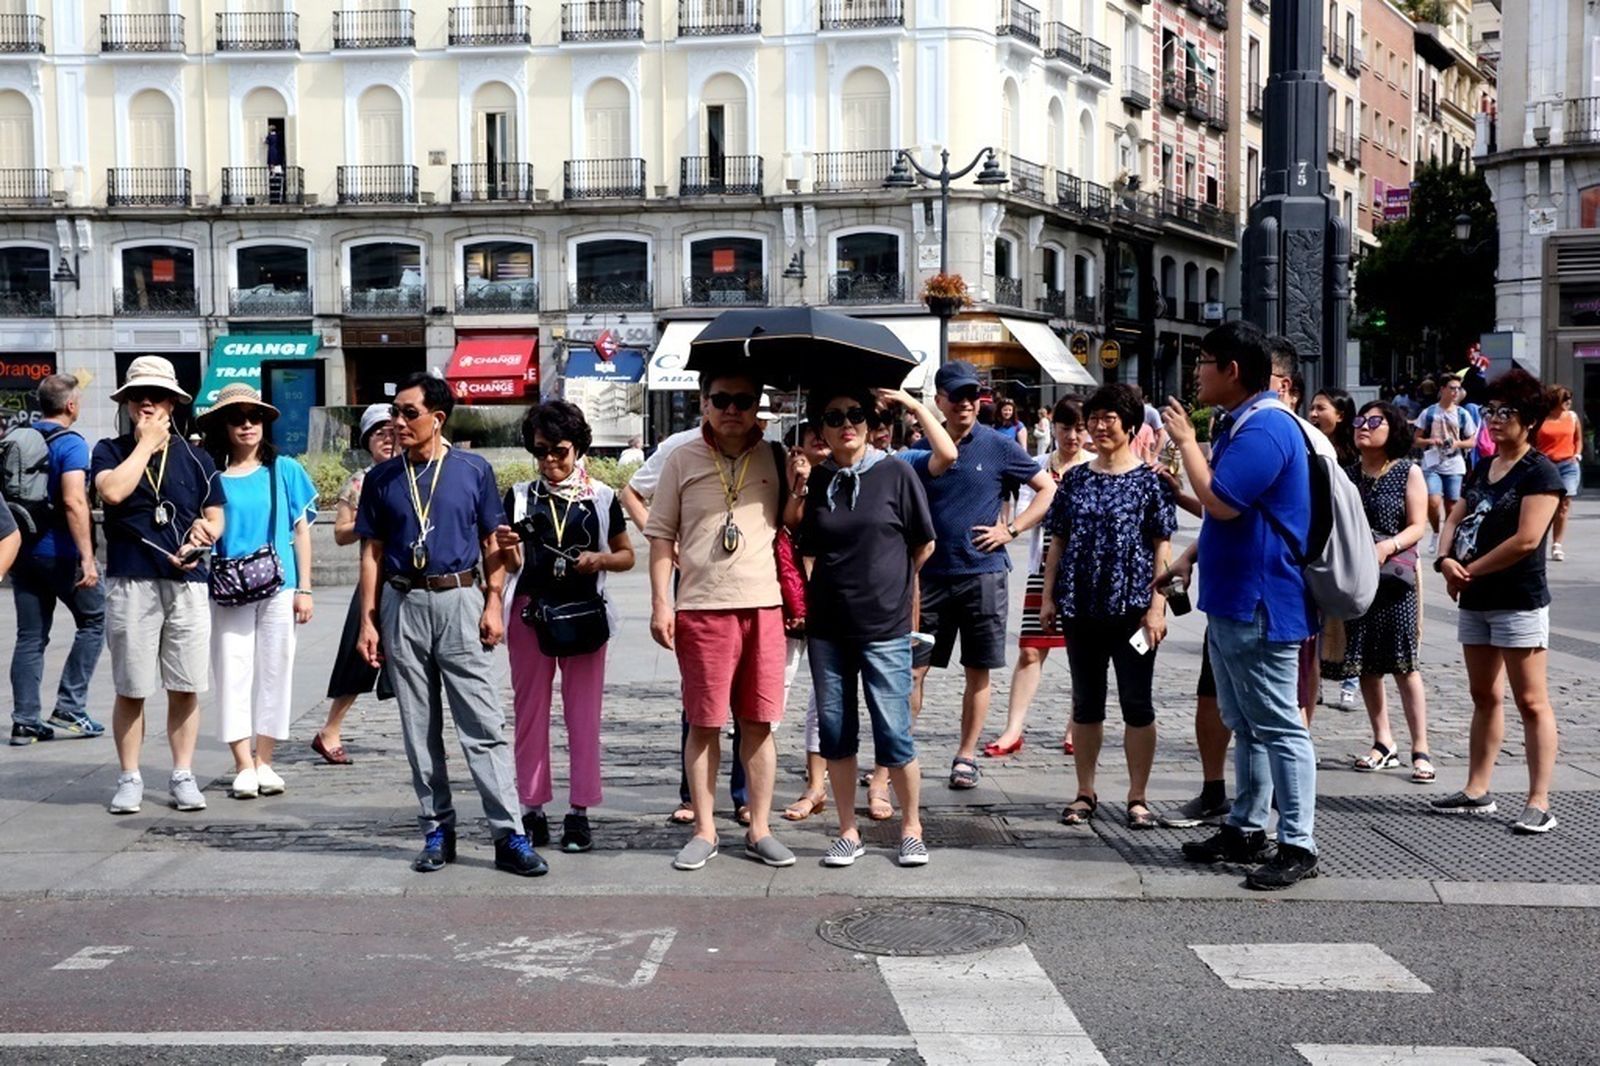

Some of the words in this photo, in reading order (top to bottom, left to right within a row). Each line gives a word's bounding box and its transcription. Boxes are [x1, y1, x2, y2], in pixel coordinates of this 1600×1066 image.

[223, 343, 307, 355] CHANGE
[474, 355, 522, 365] CHANGE
[468, 383, 513, 393] CHANGE
